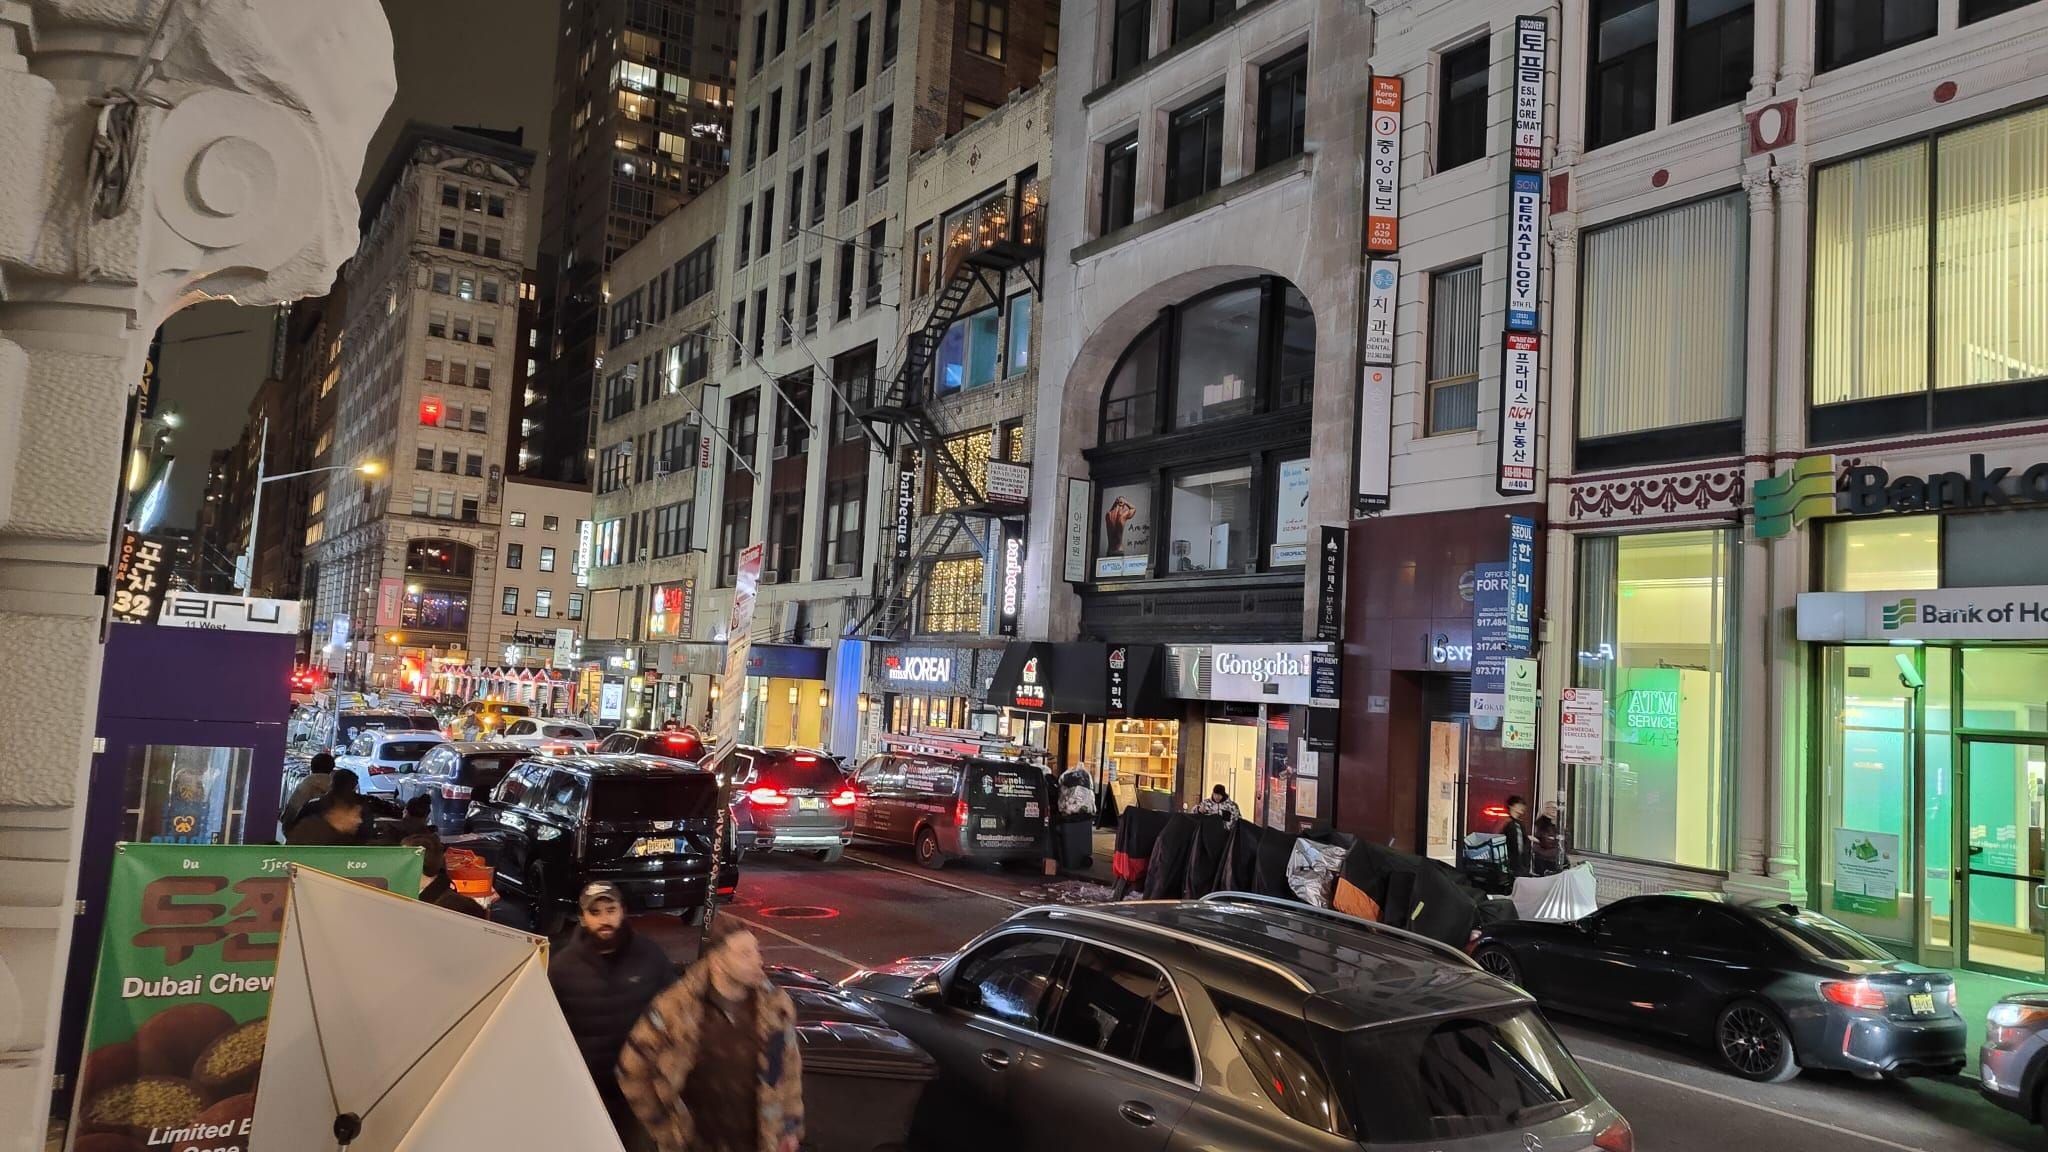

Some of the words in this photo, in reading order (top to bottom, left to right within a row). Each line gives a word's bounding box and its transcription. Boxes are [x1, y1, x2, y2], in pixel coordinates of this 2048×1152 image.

[1520, 20, 1545, 31] DISCOVERY
[1380, 82, 1394, 91] The
[1521, 86, 1536, 96] ESL
[1375, 90, 1398, 98] Korea
[1376, 97, 1395, 107] Daily
[1520, 98, 1536, 108] SAT
[1519, 109, 1536, 120] GRE
[1516, 120, 1541, 132] GMAT
[1523, 134, 1534, 144] 6F
[1375, 139, 1394, 211] 중앙일보
[1375, 222, 1391, 230] 212
[1371, 237, 1392, 245] 0700
[1516, 196, 1534, 298] DERMATOLOGY
[1525, 301, 1533, 309] FL
[1371, 296, 1388, 335] 치과
[1368, 336, 1390, 344] JOEUN
[1366, 343, 1391, 351] DENTAL
[1514, 352, 1529, 404] 프라미스
[1507, 406, 1534, 420] RICH
[1512, 421, 1527, 463] 부동산
[1508, 480, 1528, 489] #404
[1849, 453, 2016, 514] Bank
[897, 471, 915, 544] barbecue
[1511, 525, 1532, 540] SEOUL
[115, 535, 136, 582] POCHA
[126, 540, 163, 593] 포차
[1003, 537, 1022, 615] barbecue
[1484, 570, 1504, 578] OFFICE
[1477, 579, 1499, 591] FOR
[1510, 541, 1518, 621] ACUPUNCTURE
[1516, 543, 1532, 623] 한의원
[112, 590, 150, 617] 32
[164, 597, 281, 624] aru
[1922, 601, 1982, 624] Bank
[1987, 602, 2014, 623] of
[184, 620, 195, 629] 11
[199, 621, 227, 631] West
[1313, 656, 1323, 664] FOR
[1324, 657, 1338, 665] RENT
[1628, 690, 1678, 715] ATM
[1566, 714, 1573, 723] 3
[1627, 714, 1677, 729] SERVICE
[183, 859, 200, 870] Du
[121, 974, 202, 998] Dubai
[146, 1119, 236, 1146] Limited
